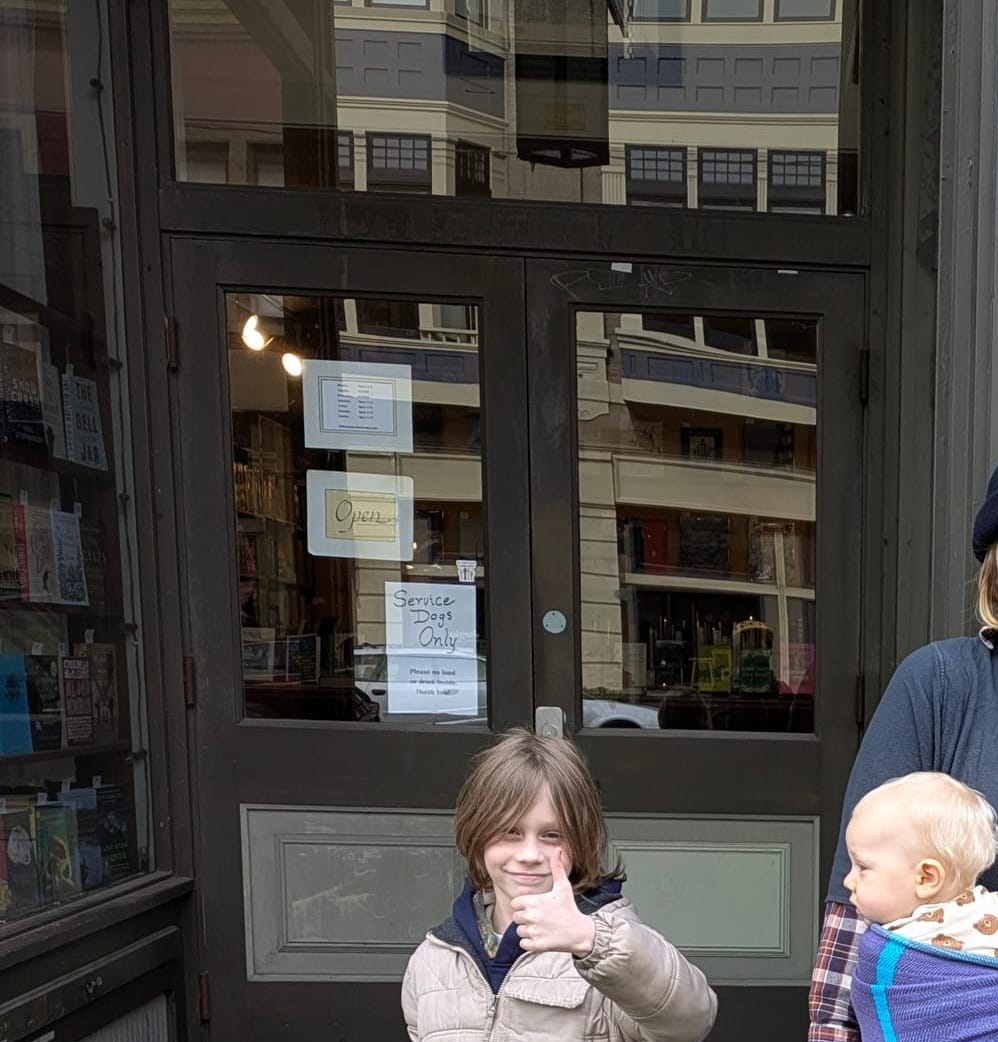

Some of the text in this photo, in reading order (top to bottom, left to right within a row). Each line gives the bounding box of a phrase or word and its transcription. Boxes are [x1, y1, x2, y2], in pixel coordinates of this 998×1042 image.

[336, 500, 391, 533] Open
[393, 589, 456, 608] Service
[410, 609, 453, 628] Dogs
[419, 626, 457, 653] Only
